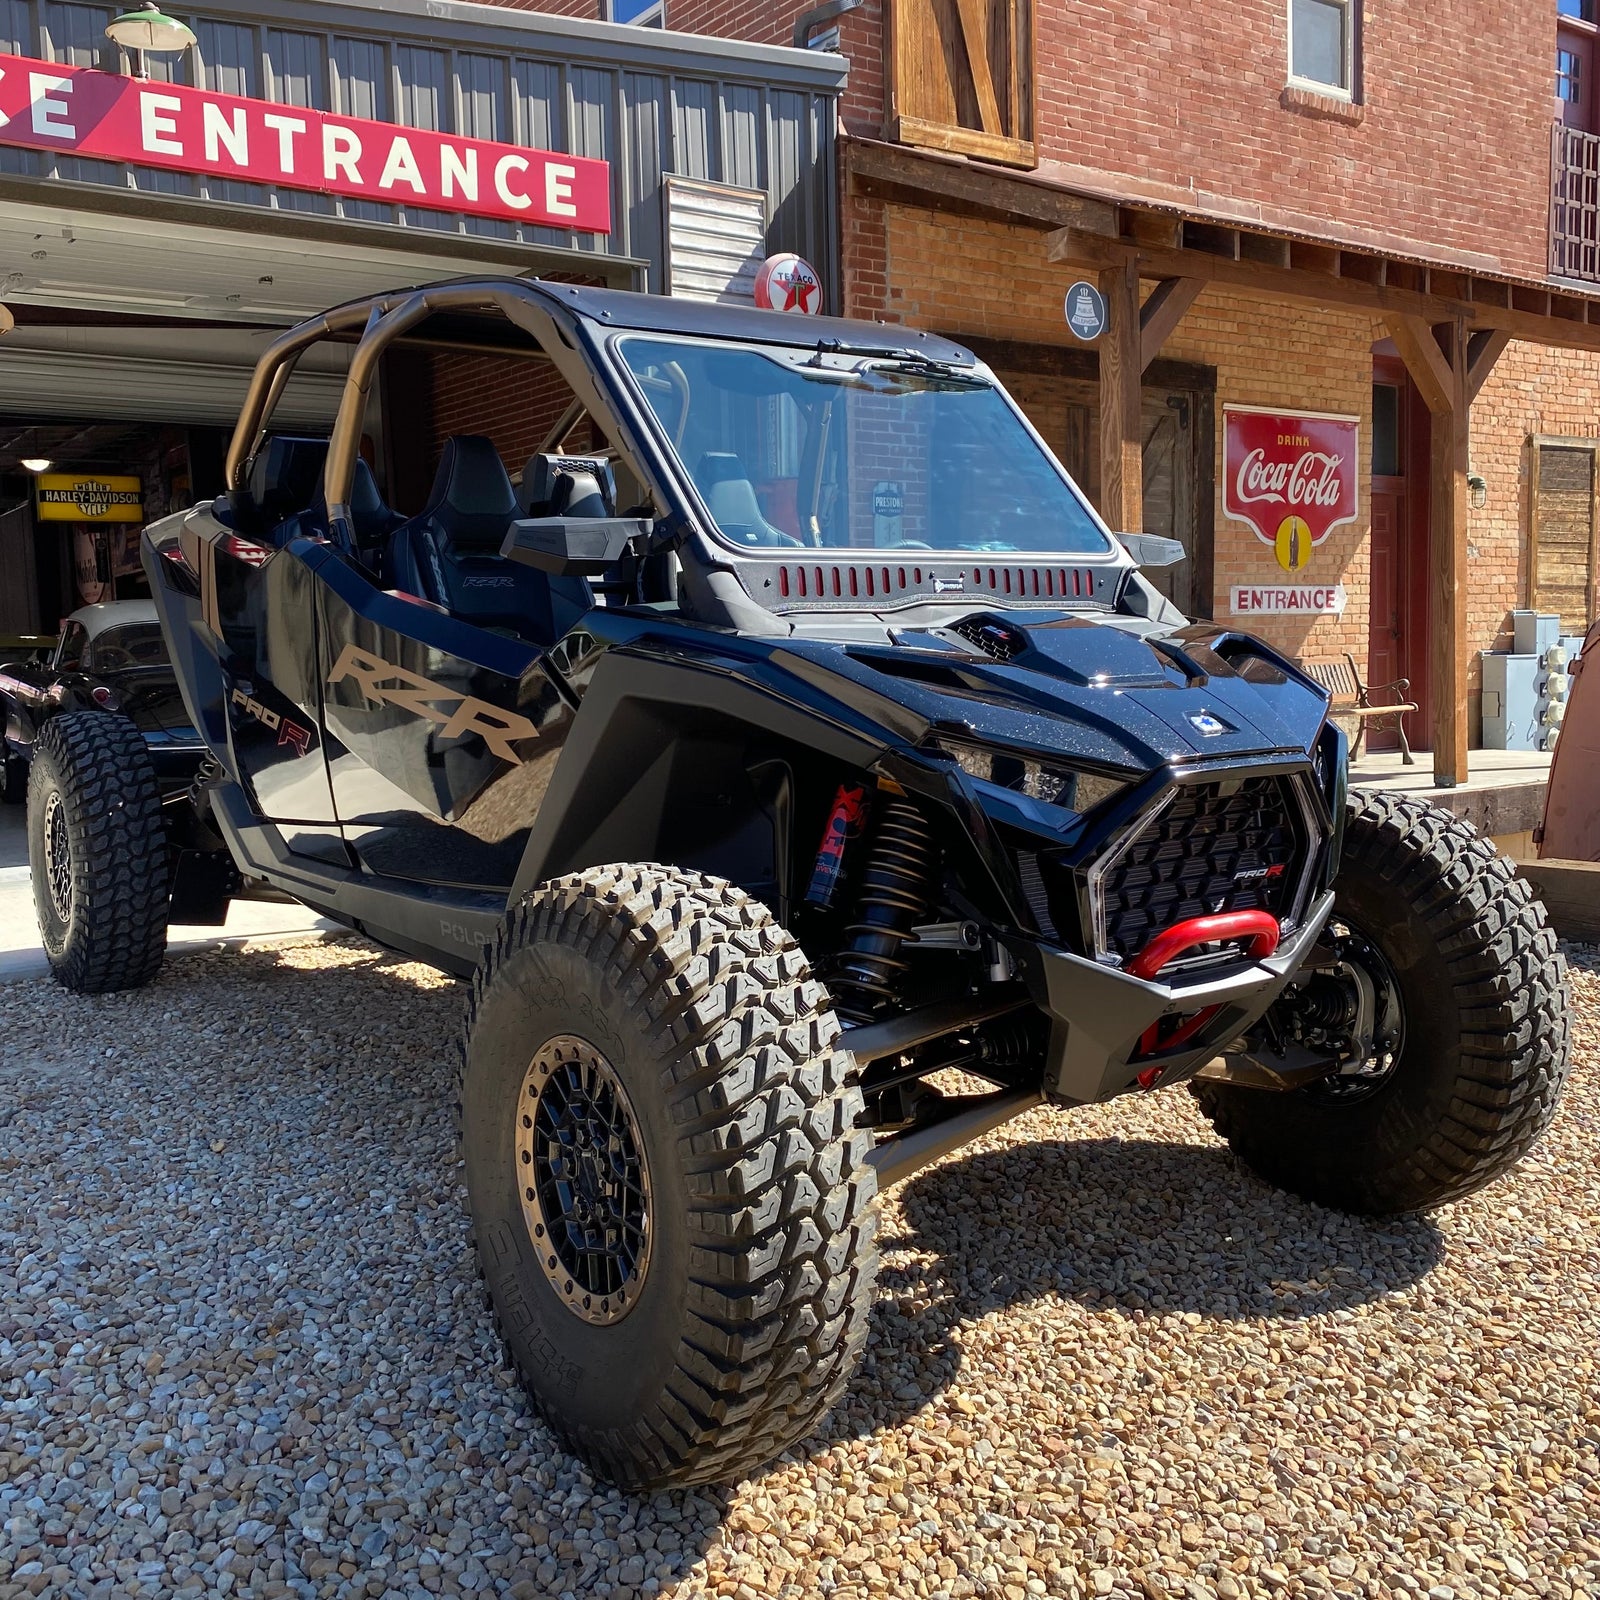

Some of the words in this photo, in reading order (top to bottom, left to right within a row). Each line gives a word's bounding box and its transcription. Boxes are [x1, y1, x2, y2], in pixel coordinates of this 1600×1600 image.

[140, 91, 577, 217] ENTRANCE
[778, 272, 813, 284] TEXACO
[1277, 434, 1310, 447] DRINK
[1236, 448, 1344, 506] Coca-Cola
[45, 490, 139, 504] HARLEY-DAVIDSON
[463, 576, 515, 588] RZR
[1237, 590, 1336, 610] ENTRANCE
[327, 643, 540, 766] RZR
[818, 784, 864, 858] FOX
